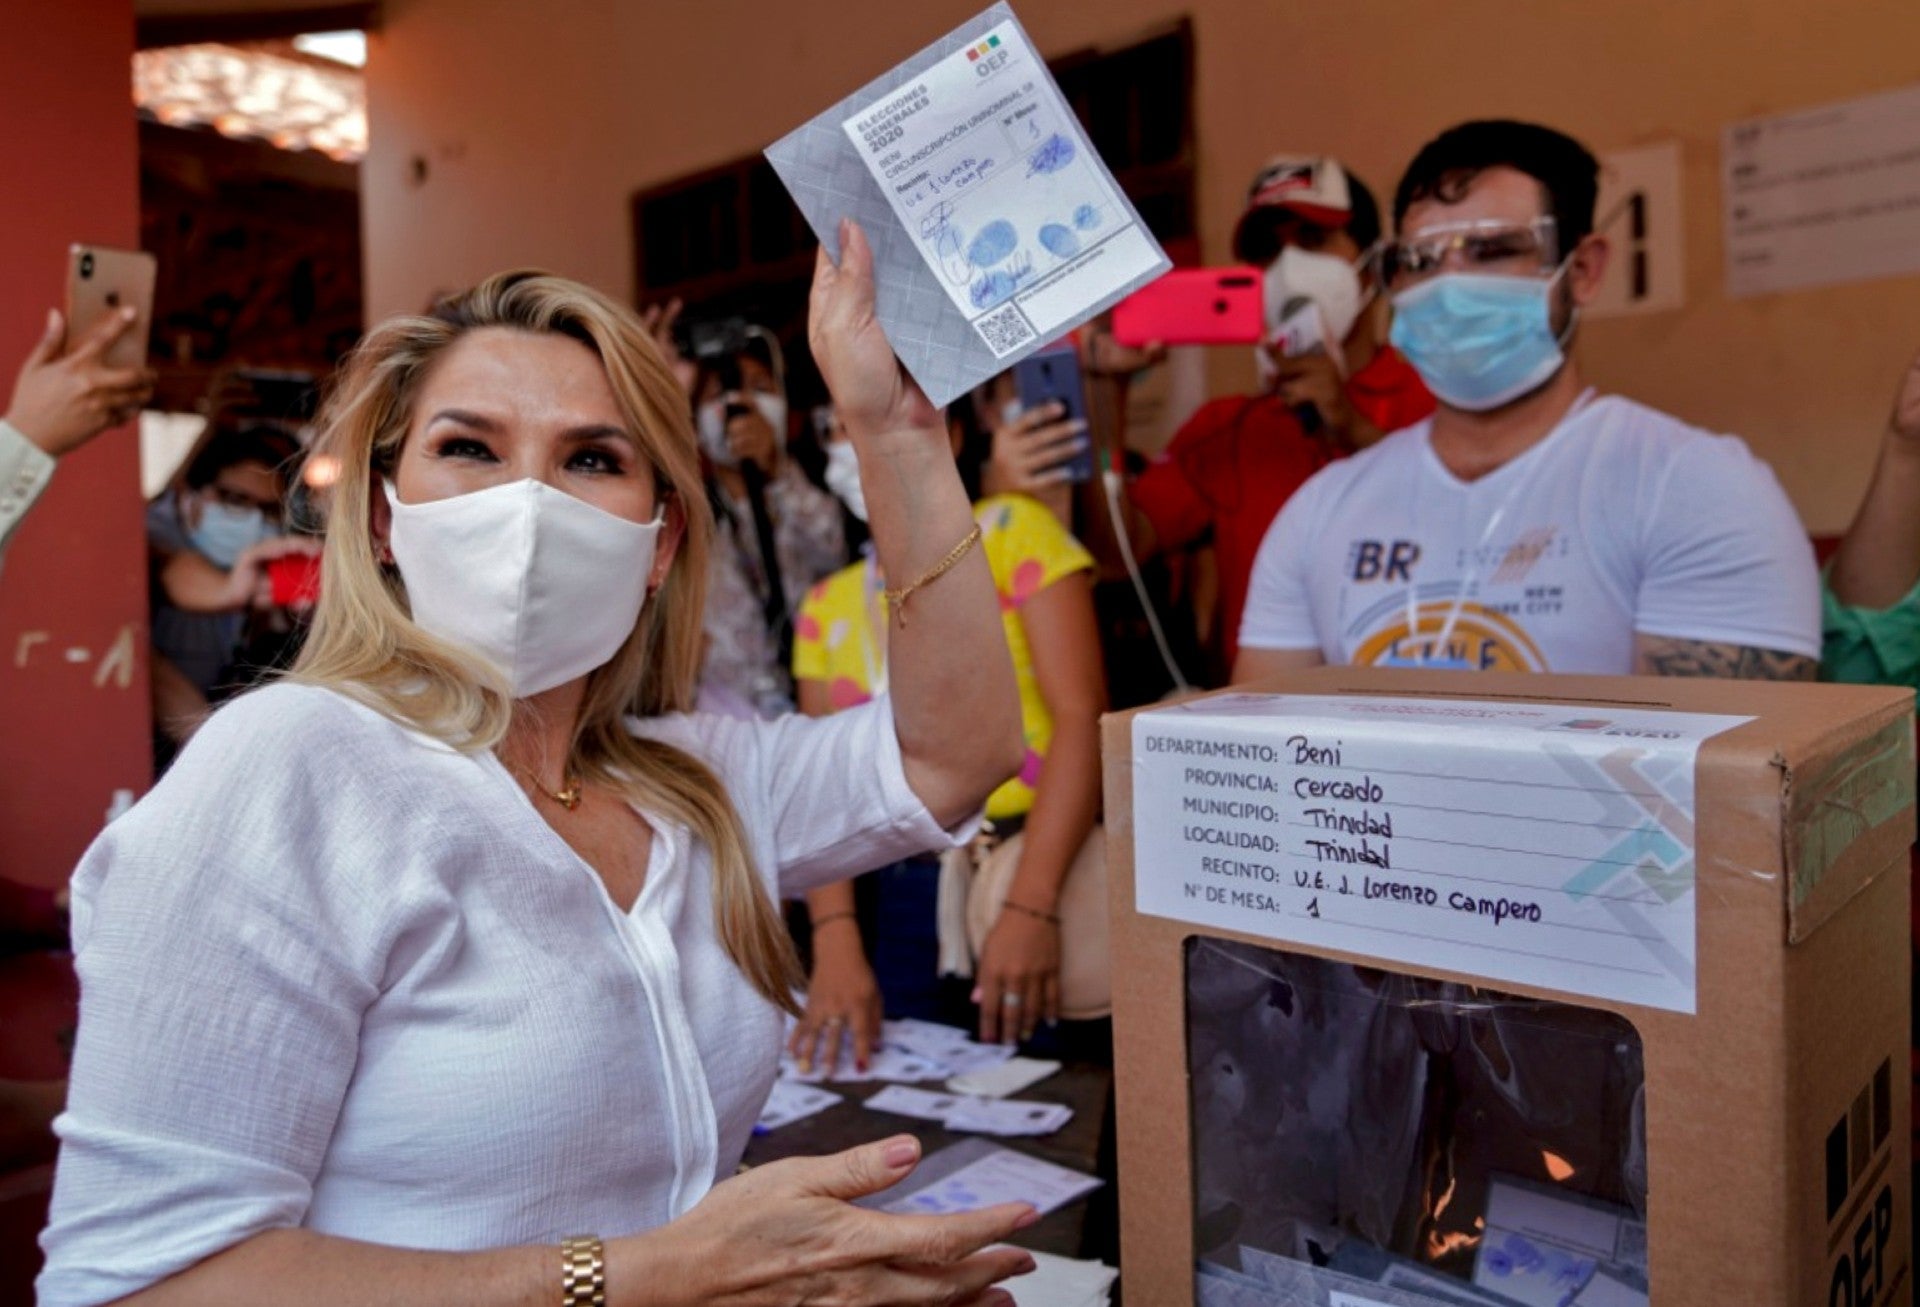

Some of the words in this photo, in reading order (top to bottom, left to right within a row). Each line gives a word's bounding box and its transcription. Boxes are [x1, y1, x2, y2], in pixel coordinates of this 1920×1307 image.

[976, 50, 1008, 77] OEP
[856, 83, 928, 132] ELECCIONES
[863, 97, 930, 142] GENERALES
[869, 126, 904, 153] 2020
[884, 124, 969, 179] CIRCUNSCRIPCIÓN
[878, 151, 902, 169] BENI
[1525, 586, 1563, 598] NEW
[1526, 601, 1562, 614] CITY
[1146, 736, 1278, 763] DEPARTAMENTO:
[1286, 735, 1342, 766] Beni
[1184, 768, 1278, 792] PROVINCIA:
[1183, 797, 1279, 822] MUNICIPIO:
[1303, 808, 1392, 838] Trinidad
[1184, 826, 1279, 852] LOCALIDAD:
[1305, 838, 1390, 869] Trinidad
[1202, 857, 1280, 883] RECINTO:
[1364, 876, 1437, 905] Lorenzo
[1206, 886, 1226, 904] DE
[1231, 890, 1280, 913] MESA:
[1306, 897, 1320, 918] 1
